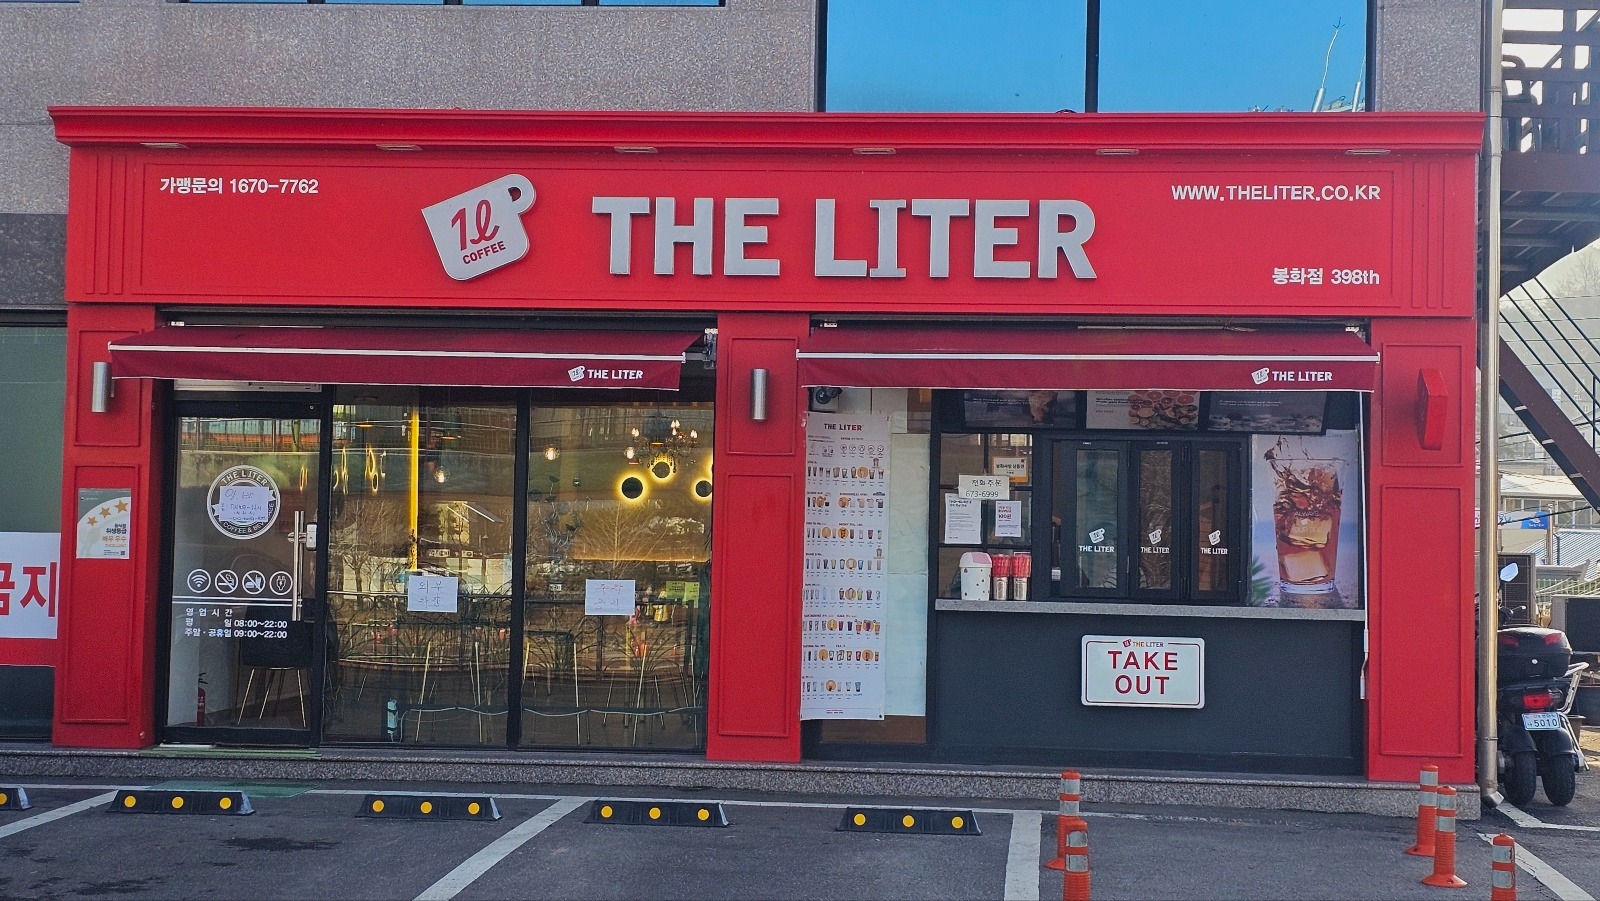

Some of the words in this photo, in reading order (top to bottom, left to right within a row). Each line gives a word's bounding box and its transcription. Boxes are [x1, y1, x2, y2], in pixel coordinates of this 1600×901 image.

[159, 177, 223, 195] 가맹문의
[229, 178, 319, 195] 1670-7762
[1171, 185, 1382, 202] WWW.THELITER.CO.KR
[592, 196, 781, 277] THE
[814, 198, 1098, 280] LITER
[462, 241, 507, 265] COFFEE
[1272, 267, 1324, 285] 봉화점
[1330, 269, 1381, 285] 398th
[587, 369, 609, 379] THE
[611, 369, 644, 380] LITER
[1271, 371, 1295, 381] THE
[1298, 371, 1333, 382] LITER
[824, 423, 837, 431] THE
[839, 424, 862, 432] LITER
[221, 471, 239, 485] THE
[241, 469, 269, 487] LITER
[972, 478, 986, 487] 전화
[987, 478, 1002, 487] 주문
[965, 490, 999, 498] 673-6999
[223, 522, 247, 534] COFFEE
[1078, 545, 1093, 553] THE
[1094, 545, 1115, 553] LITER
[1140, 546, 1152, 554] THE
[1200, 547, 1212, 555] THE
[1212, 547, 1228, 555] LITER
[234, 619, 288, 629] 08:00~22:00
[234, 630, 288, 640] 09:00~22:00
[1146, 641, 1165, 649] LITER
[1107, 650, 1179, 671] TAKE
[1115, 674, 1171, 696] OUT
[1533, 718, 1558, 728] 5010
